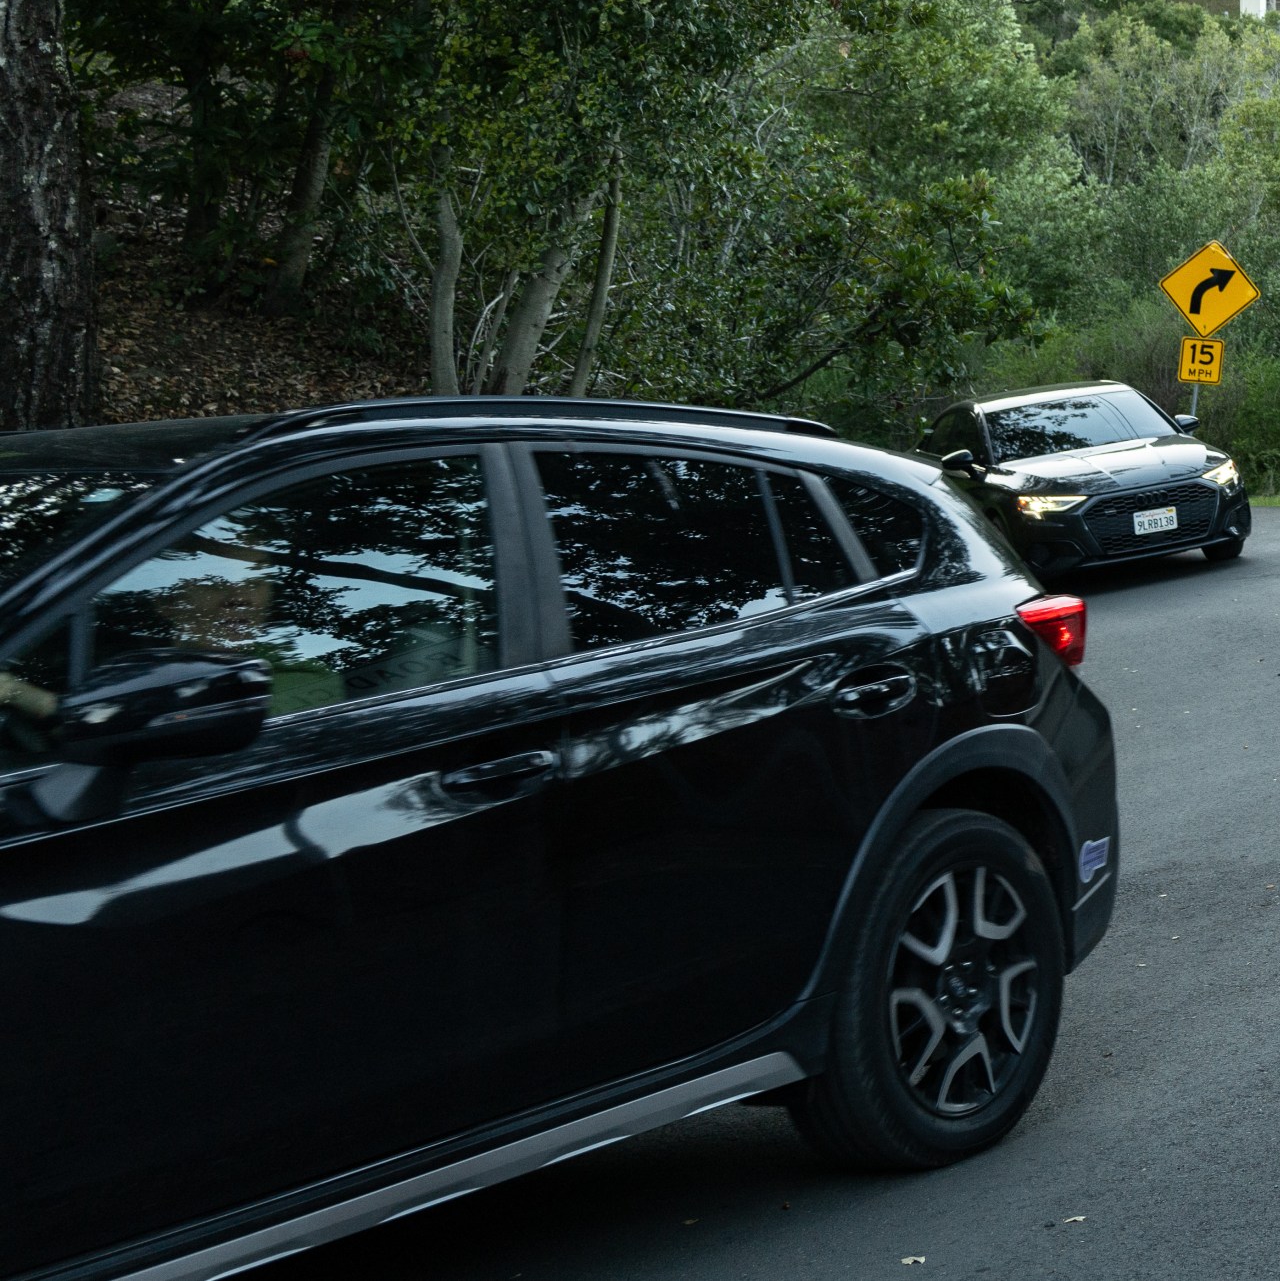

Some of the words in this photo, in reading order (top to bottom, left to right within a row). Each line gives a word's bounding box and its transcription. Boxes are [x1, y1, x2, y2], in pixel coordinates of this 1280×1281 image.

[1190, 343, 1214, 366] 15
[1188, 368, 1212, 378] MPH
[1138, 516, 1175, 531] 9LRB138
